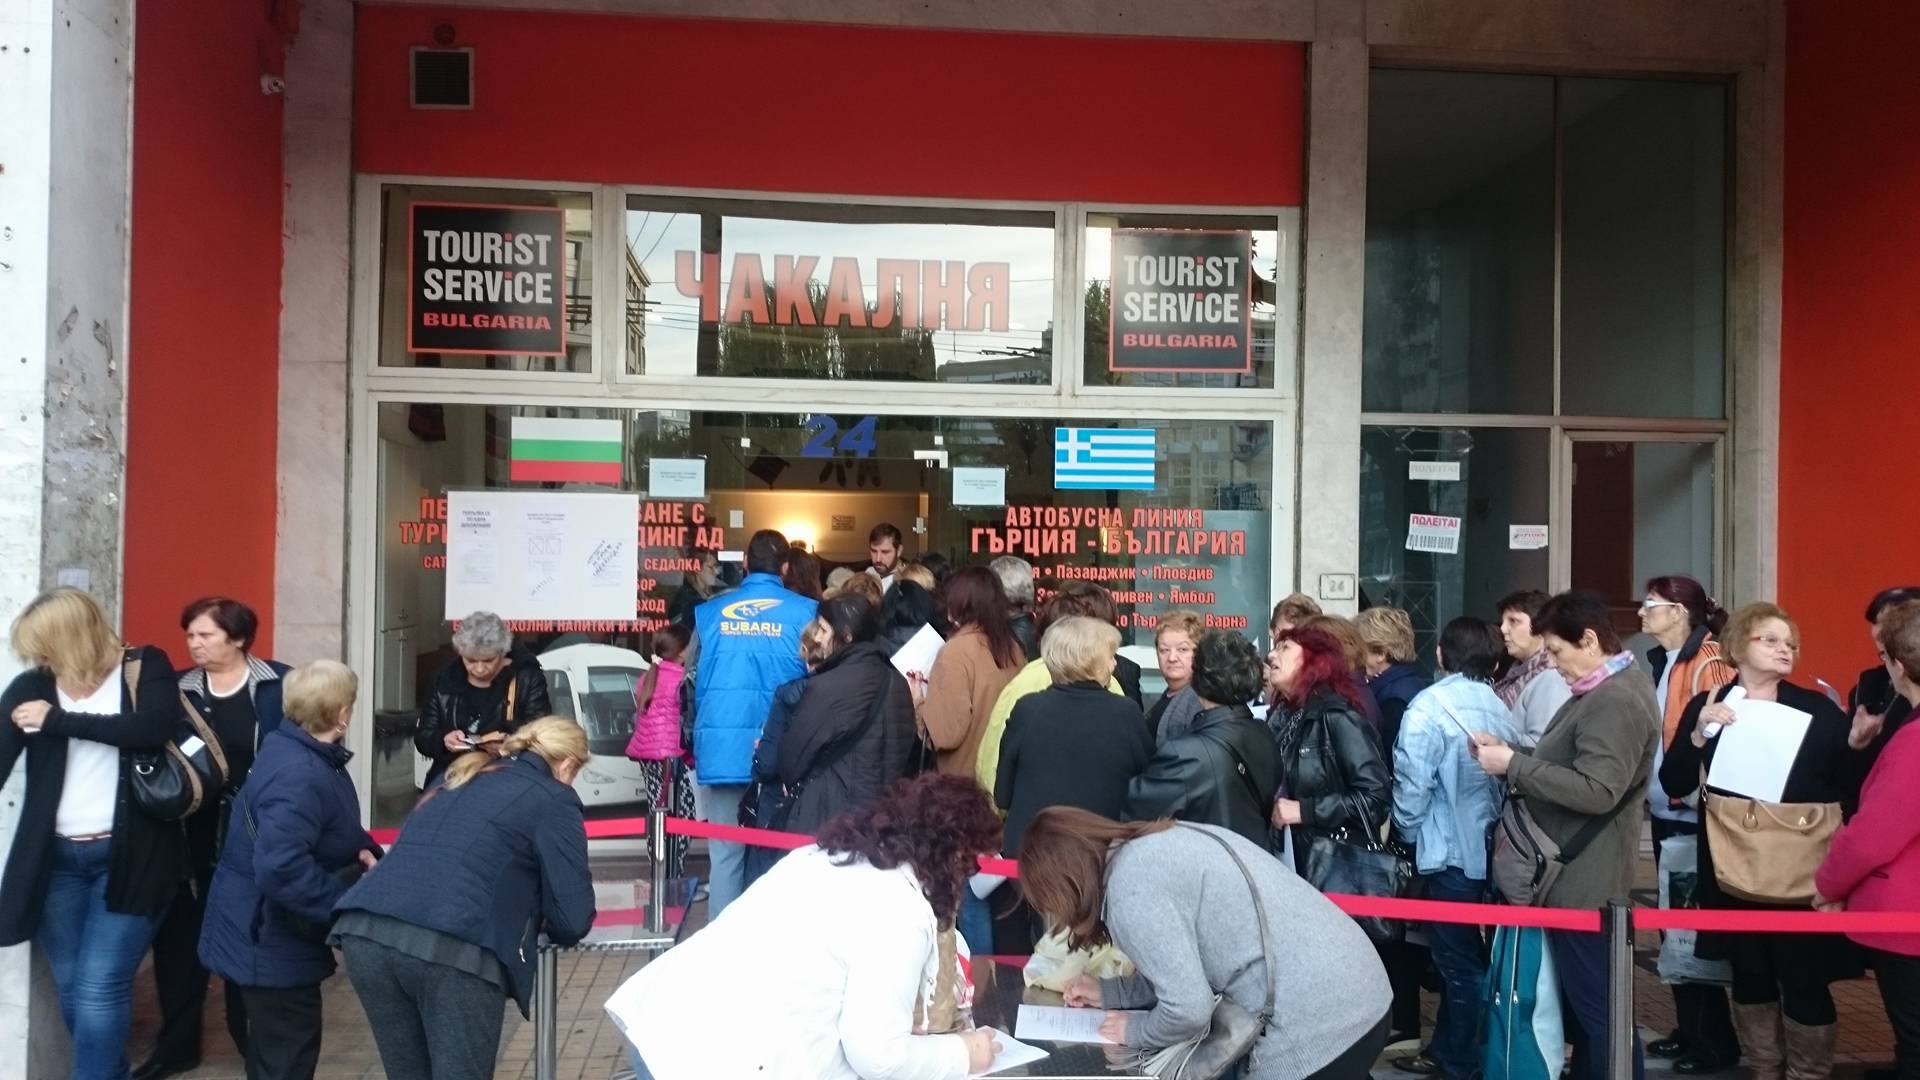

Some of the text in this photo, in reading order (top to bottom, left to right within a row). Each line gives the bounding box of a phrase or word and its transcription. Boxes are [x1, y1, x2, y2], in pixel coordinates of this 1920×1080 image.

[423, 230, 551, 266] TOURiST
[1124, 255, 1240, 287] TOURiST
[424, 268, 553, 304] SERViCE
[674, 250, 1010, 332] ЧАКАЛНЯ
[1124, 292, 1240, 323] SERViCE
[423, 313, 552, 330] BULGARIA
[1123, 334, 1238, 348] BULGARIA
[800, 415, 879, 458] 24
[638, 502, 684, 524] АНЕ
[1006, 507, 1203, 528] АВТОБУСНА ЛИНИЯ
[1411, 515, 1458, 528] ΠΩΛΕΙΤΑΙ
[696, 528, 725, 550] АД
[971, 528, 1077, 557] ГЪРЦИЯ
[1107, 530, 1246, 556] БЪЛГАРИЯ
[644, 558, 701, 572] СЕДАЛКА
[1056, 565, 1136, 581] Пазарджик
[1152, 566, 1213, 582] Пловдив
[1106, 588, 1215, 604] ливен Ямбол
[557, 620, 615, 633] НАПИТКИ
[619, 620, 627, 633] И
[720, 621, 783, 633] SUBARU
[1205, 613, 1247, 628] Варна
